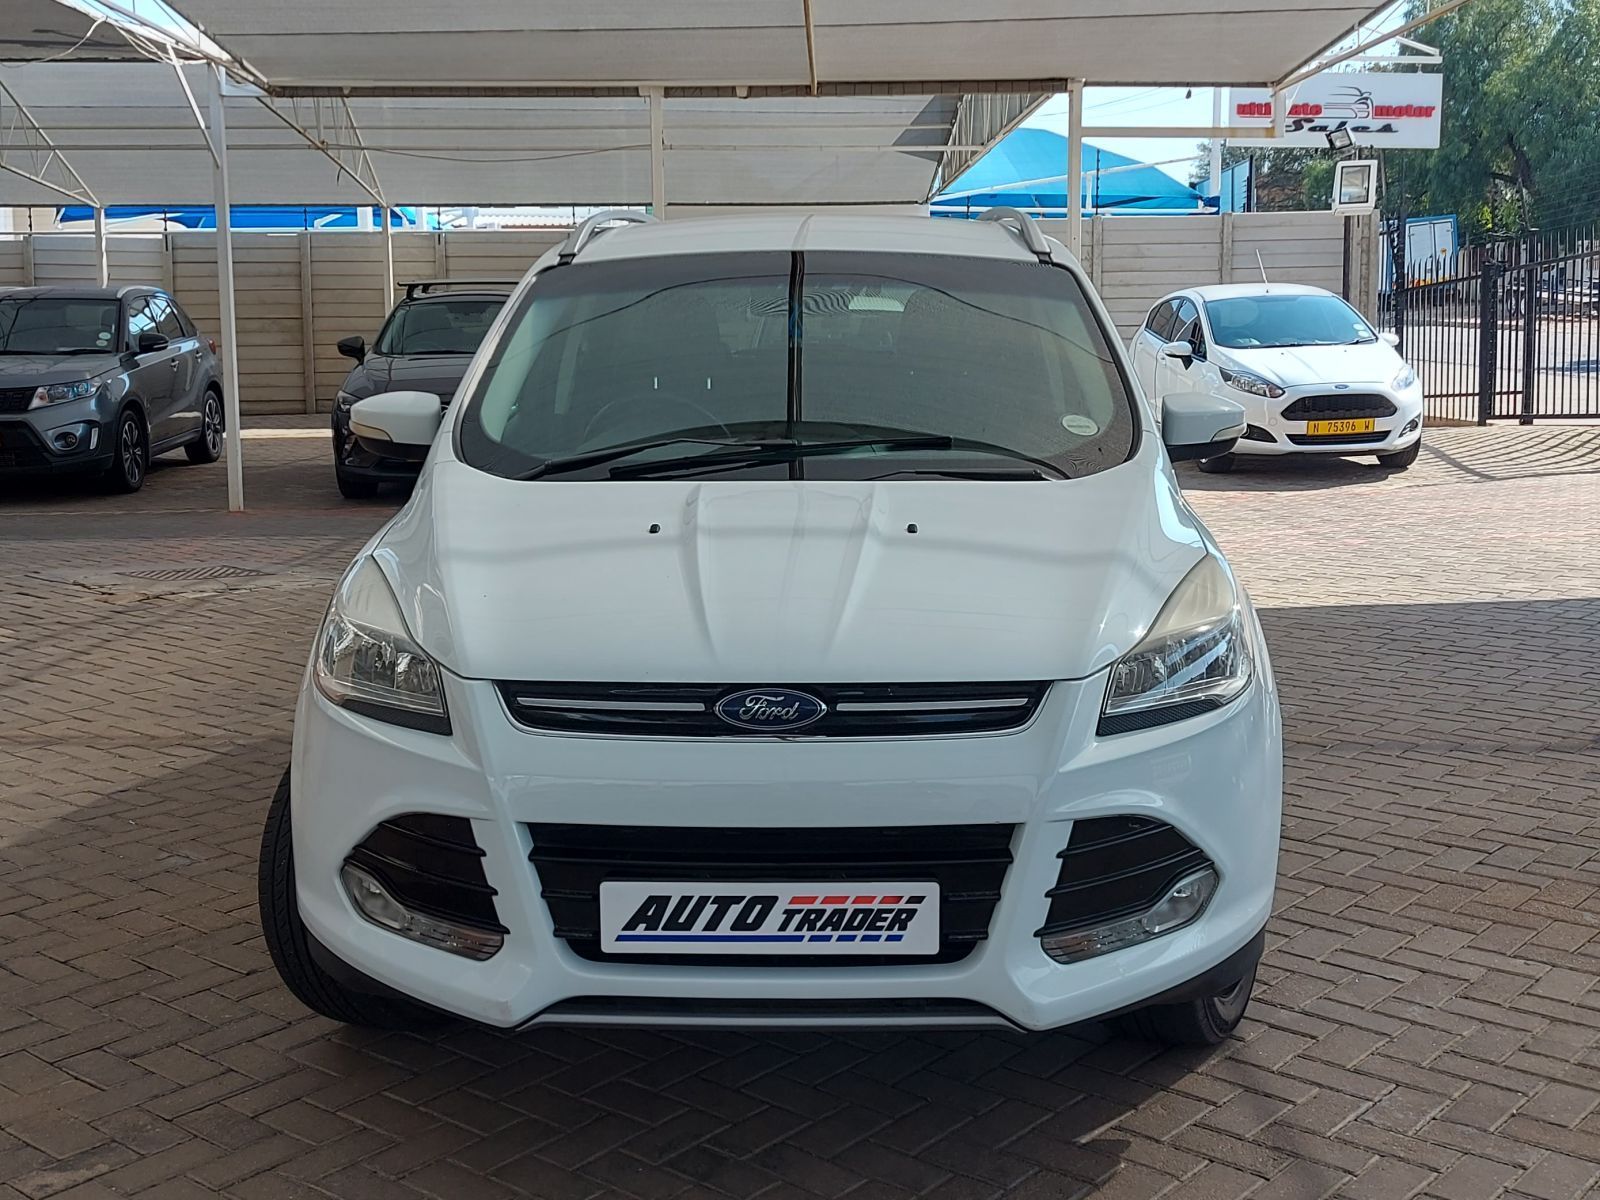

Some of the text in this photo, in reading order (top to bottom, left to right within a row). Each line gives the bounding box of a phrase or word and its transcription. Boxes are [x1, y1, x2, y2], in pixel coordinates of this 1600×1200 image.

[1236, 102, 1436, 118] ultiate motor
[1313, 420, 1370, 433] N 75396 W
[738, 694, 801, 721] Ford
[621, 895, 918, 932] AUTO TRADER
